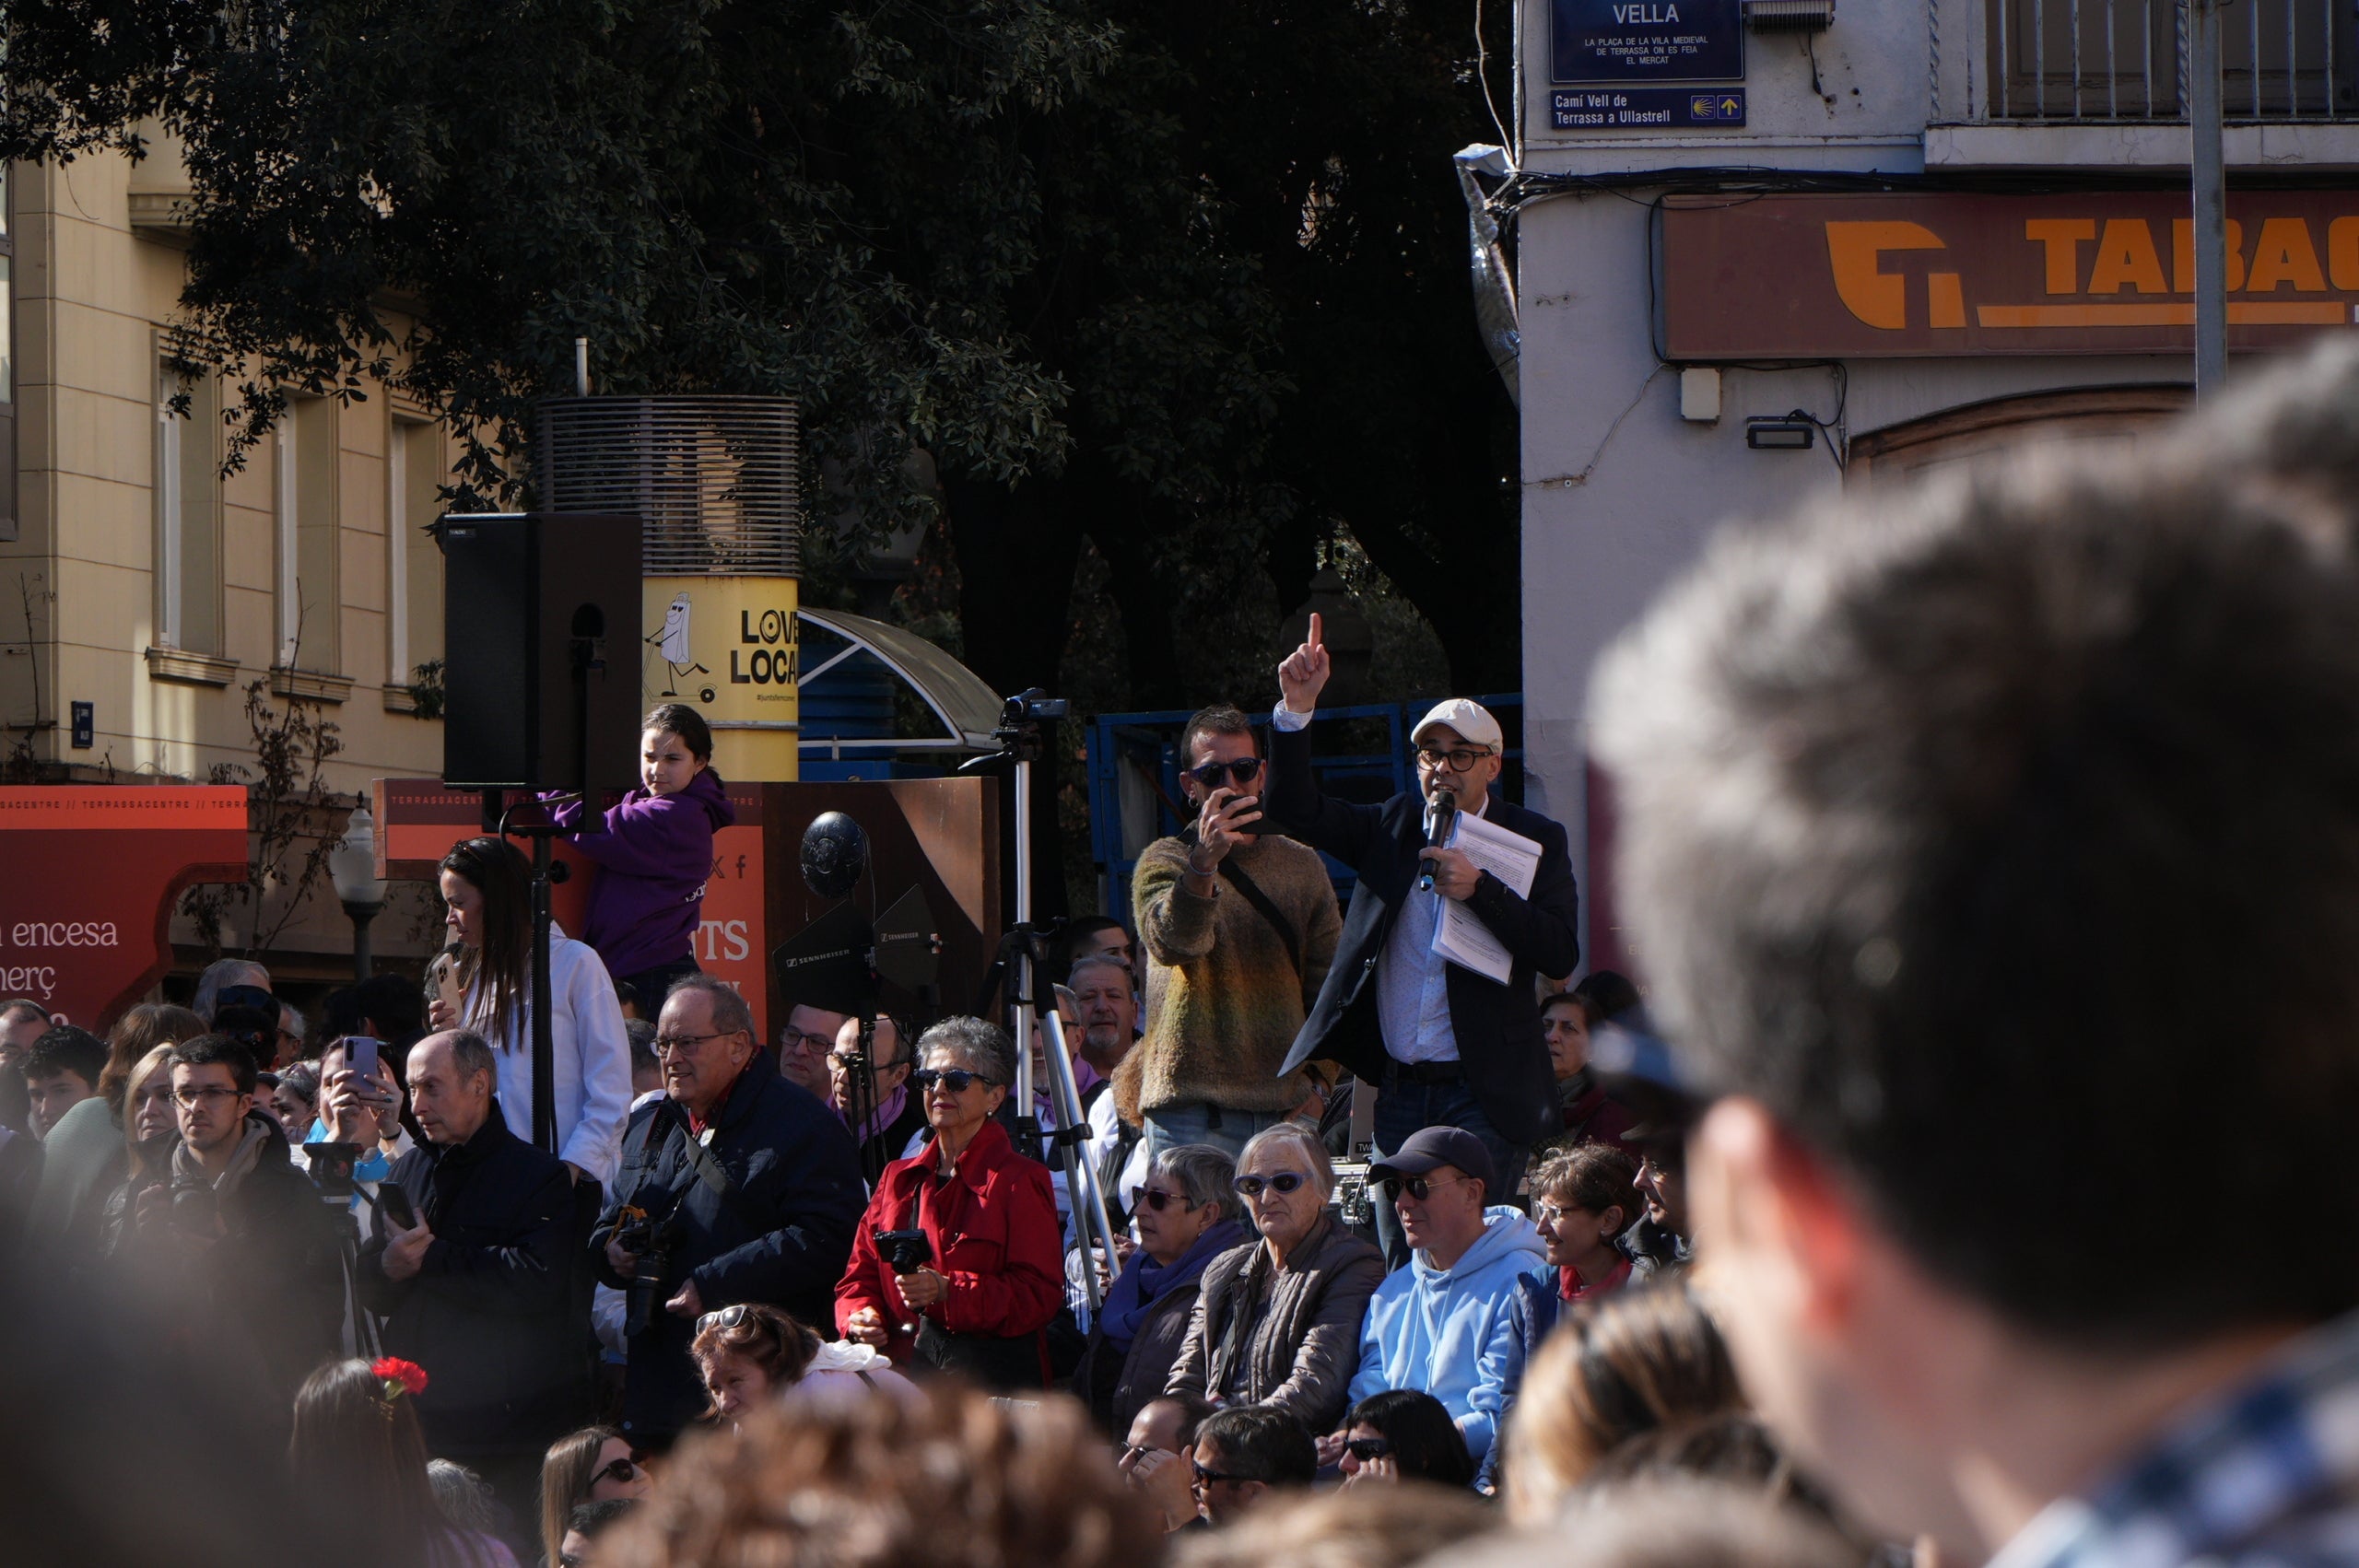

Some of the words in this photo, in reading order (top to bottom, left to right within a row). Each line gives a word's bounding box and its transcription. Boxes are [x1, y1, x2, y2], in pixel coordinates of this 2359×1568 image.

[1613, 4, 1680, 24] VELLA
[1585, 39, 1595, 47] LA
[1625, 37, 1637, 45] DE
[1638, 37, 1649, 45] LA
[1650, 36, 1669, 45] VILA
[1672, 36, 1708, 44] MEDIEVAL
[1596, 47, 1607, 55] DE
[1610, 46, 1649, 55] TERRASSA
[1653, 46, 1664, 54] ON
[1668, 46, 1678, 54] ES
[1681, 45, 1697, 53] FEIA
[1626, 56, 1636, 64] EL
[1638, 55, 1669, 64] MERCAT
[1555, 94, 1583, 108] Camí
[1587, 94, 1609, 107] Vell
[1614, 94, 1627, 107] de
[1555, 111, 1603, 124] Terrassa
[1608, 112, 1615, 123] a
[1619, 109, 1671, 123] Ullastrell
[82, 800, 191, 809] TERRASSACENTRE
[391, 795, 486, 805] TERRASSACENT
[12, 921, 119, 947] encesa
[798, 949, 851, 965] SENNHEISER
